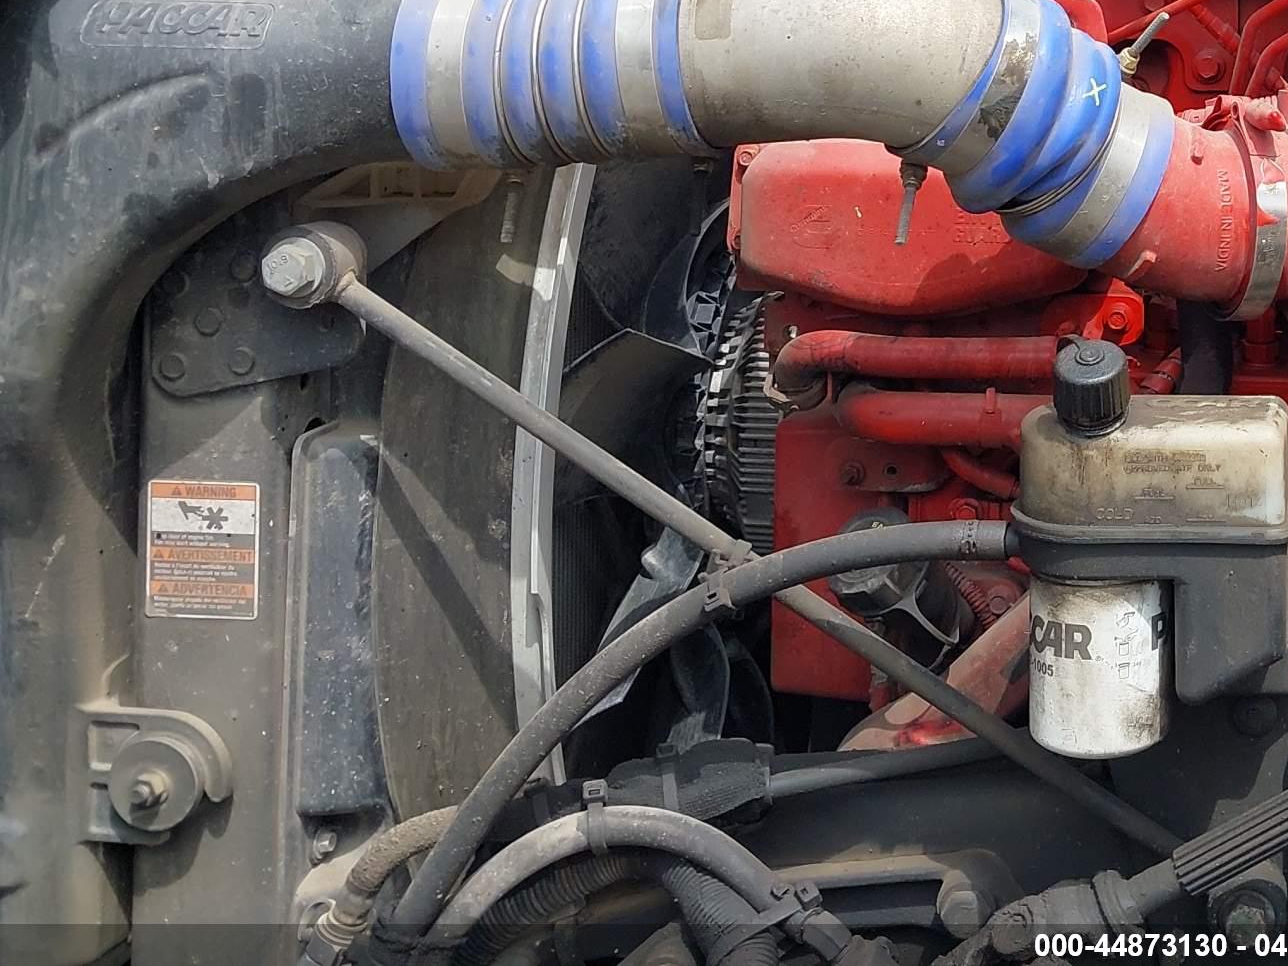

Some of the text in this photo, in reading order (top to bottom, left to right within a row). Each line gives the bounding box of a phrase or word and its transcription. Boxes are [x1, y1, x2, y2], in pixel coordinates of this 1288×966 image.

[185, 486, 237, 498] WARNING
[167, 549, 253, 562] AVERTISSEMENT
[173, 583, 247, 596] ADVERTENCIA
